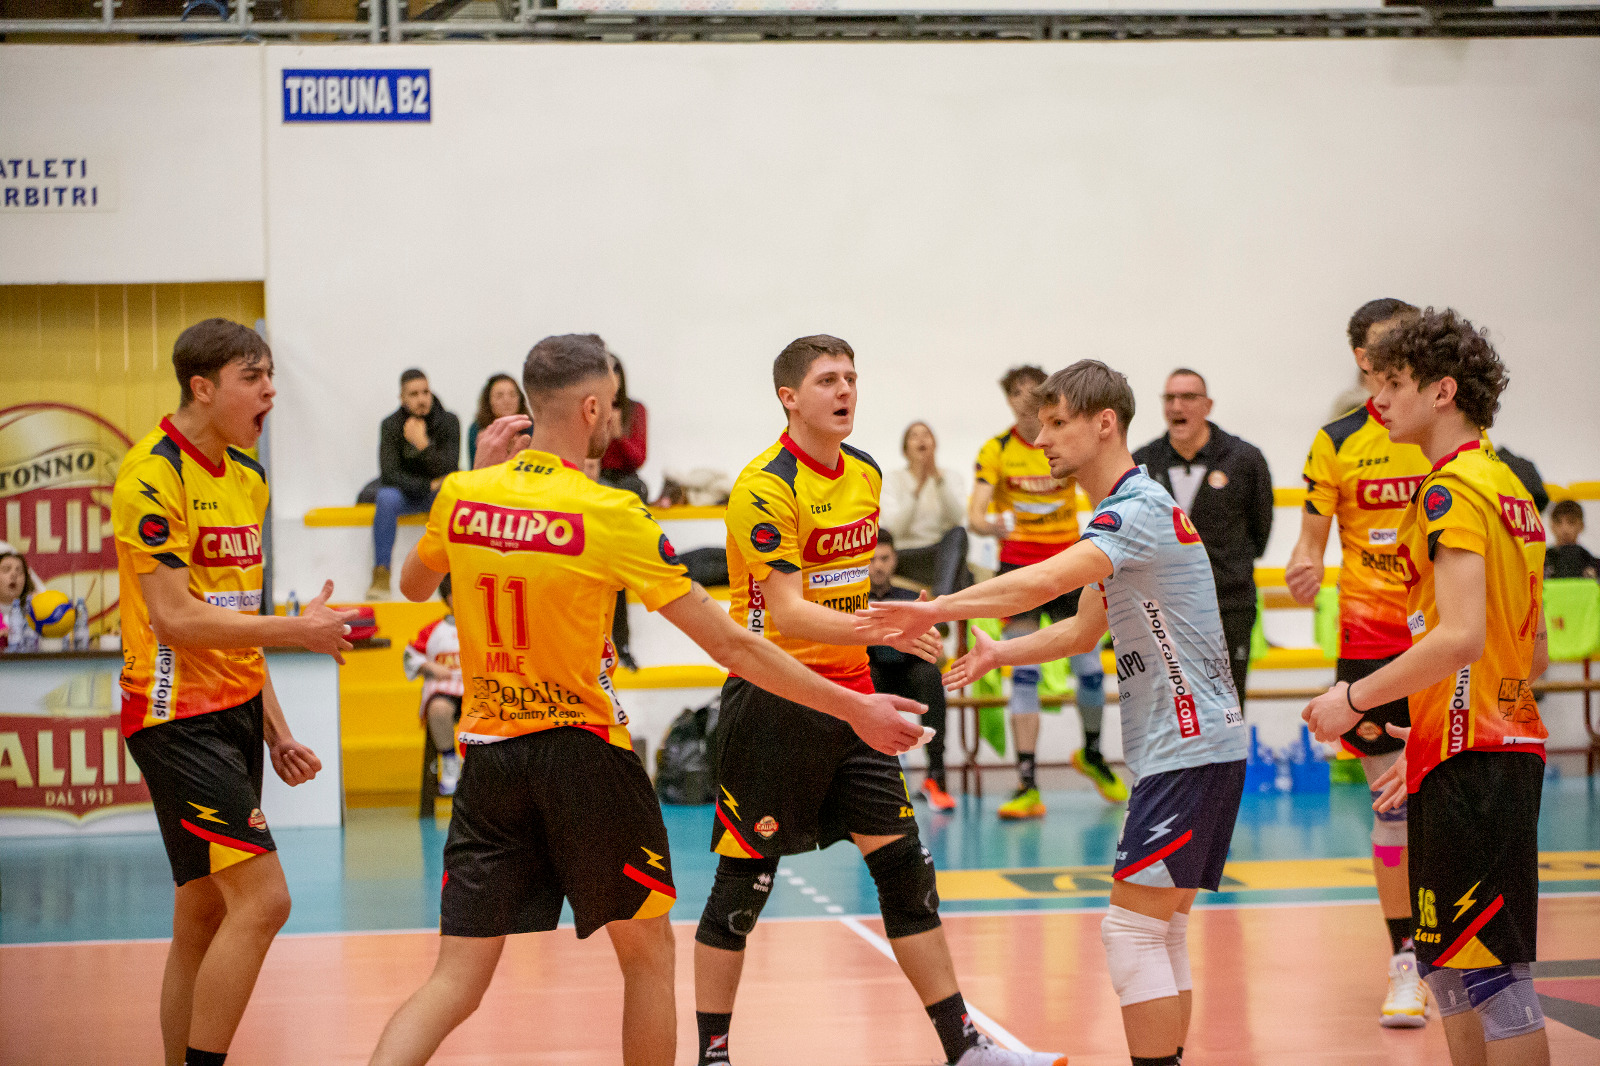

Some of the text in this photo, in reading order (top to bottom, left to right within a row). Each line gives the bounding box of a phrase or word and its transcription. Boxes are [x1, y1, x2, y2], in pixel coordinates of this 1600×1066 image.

[285, 77, 430, 115] TRIBUNA B2
[0, 186, 98, 207] RBITRI
[1363, 480, 1423, 505] CALL
[5, 488, 115, 555] LLIP
[452, 507, 574, 547] CALLIPO
[202, 527, 261, 559] CALLIP
[475, 572, 531, 651] 11
[486, 651, 526, 676] MILE
[1143, 601, 1195, 735] shop.callipo.com
[484, 679, 584, 711] Popilia
[0, 728, 142, 788] ALLI
[45, 788, 76, 806] DAL
[1418, 887, 1438, 928] 16
[1414, 928, 1442, 944] Zeus
